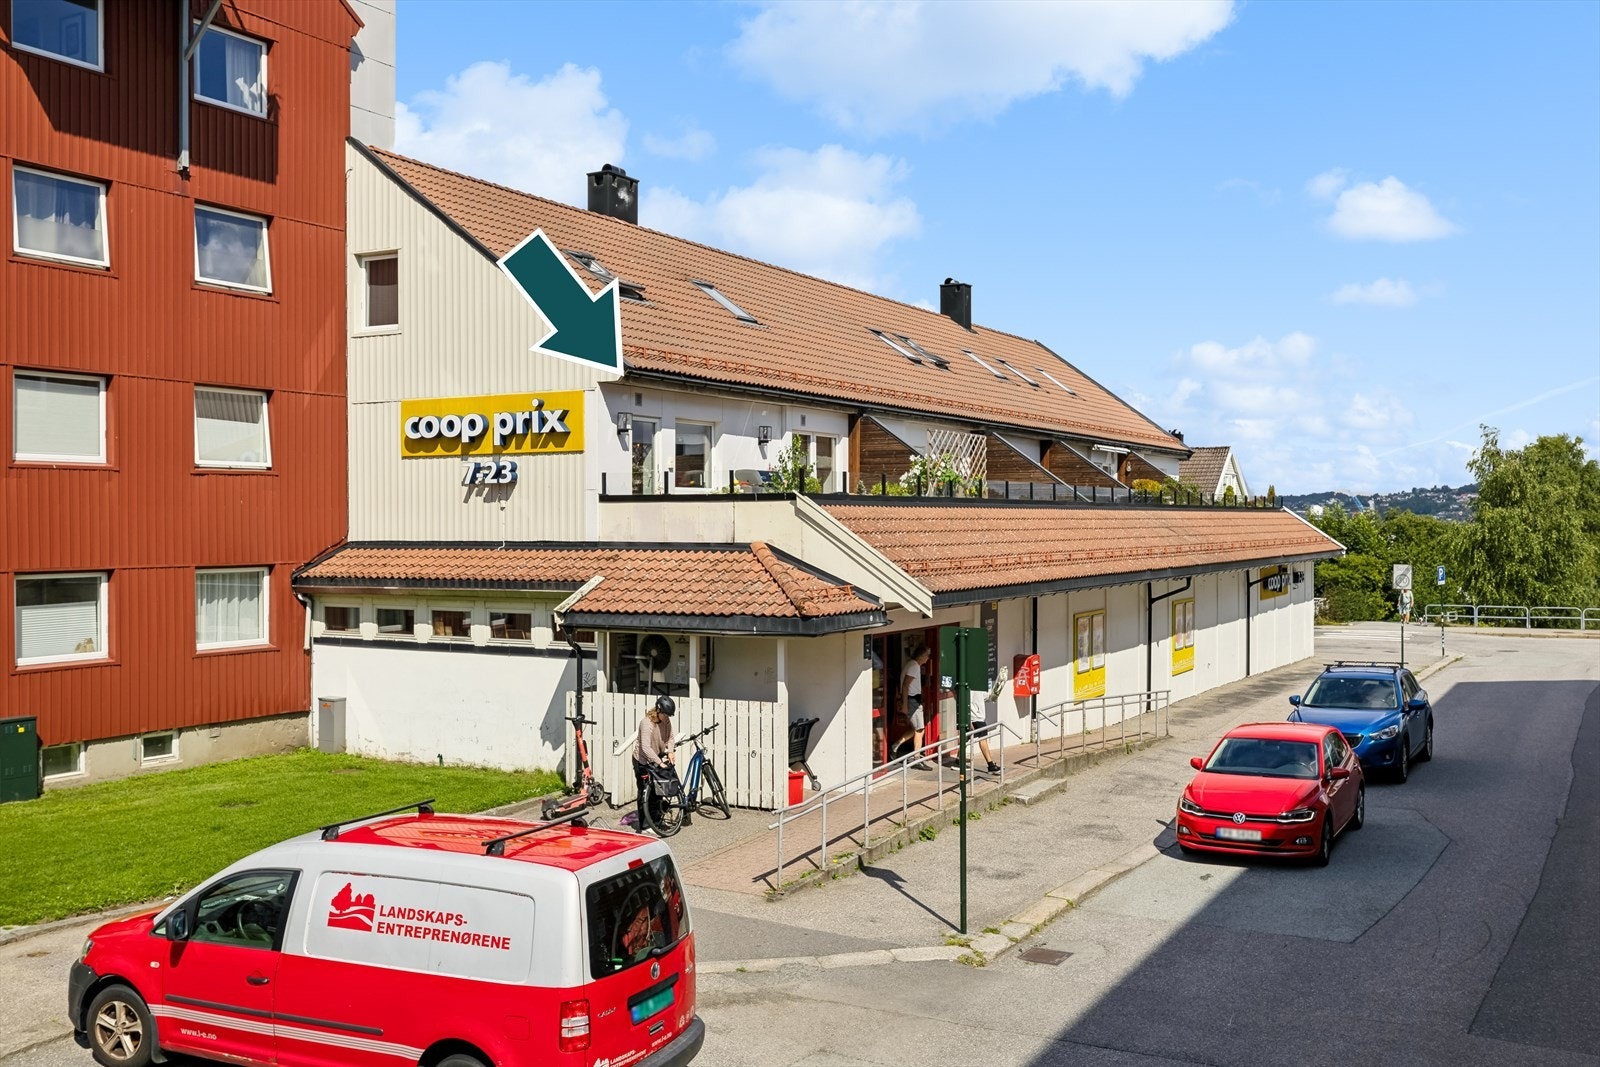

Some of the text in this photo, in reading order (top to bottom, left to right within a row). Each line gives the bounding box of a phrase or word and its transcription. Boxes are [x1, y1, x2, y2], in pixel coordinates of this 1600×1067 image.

[404, 398, 571, 446] coop prix
[379, 905, 468, 927] LANDSKAPS-
[377, 921, 511, 950] ENTREPRENØRENE
